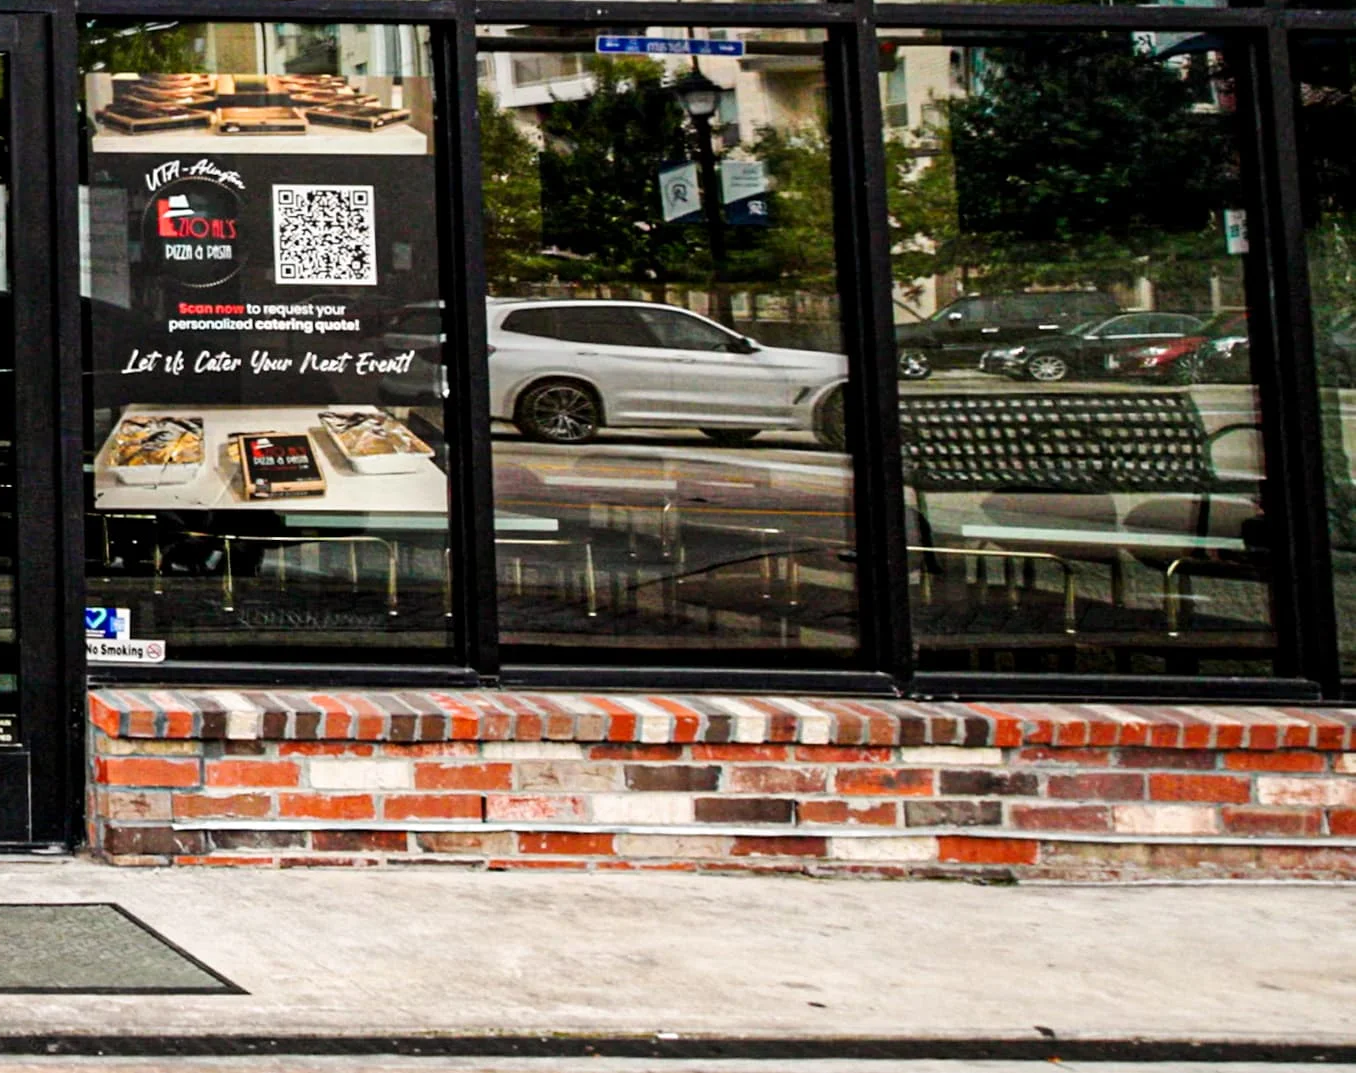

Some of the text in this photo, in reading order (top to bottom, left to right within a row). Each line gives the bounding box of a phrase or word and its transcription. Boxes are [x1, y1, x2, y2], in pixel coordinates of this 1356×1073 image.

[178, 217, 237, 239] ZIO AL'S
[165, 244, 232, 260] PIZZA & PASTA
[178, 303, 346, 319] Scan now to request your
[168, 318, 360, 333] personalized catering quote!
[121, 349, 163, 374] Let
[194, 350, 241, 373] Cater
[250, 350, 293, 375] Your
[355, 350, 415, 374] Event!
[101, 643, 144, 659] Smoking
